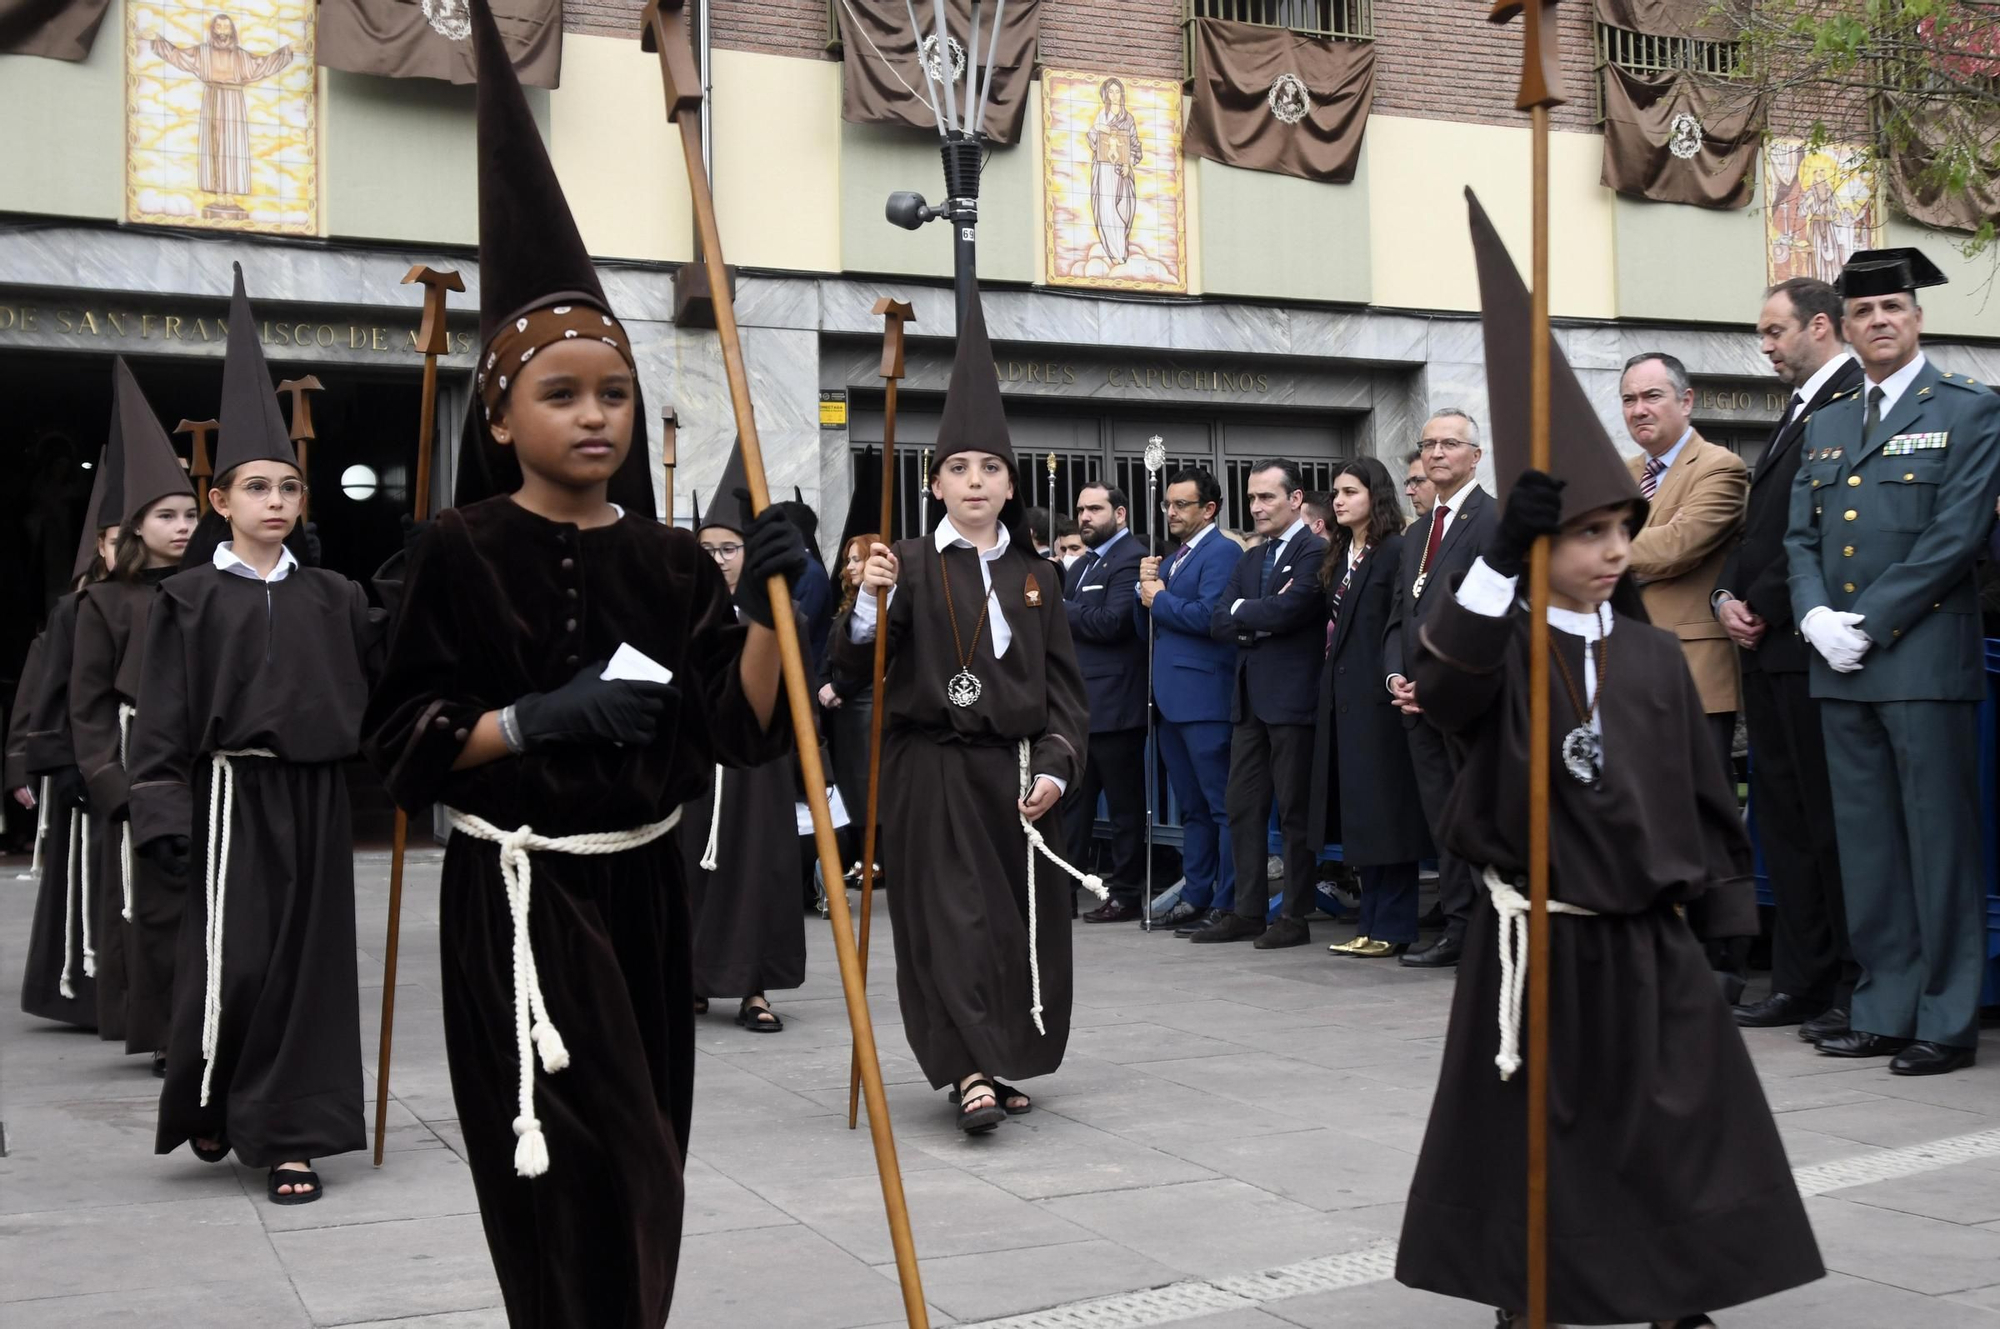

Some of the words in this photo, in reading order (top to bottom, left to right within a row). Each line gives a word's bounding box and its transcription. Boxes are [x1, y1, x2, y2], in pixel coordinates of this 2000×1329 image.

[963, 229, 974, 239] 69
[0, 306, 39, 333] DE
[56, 310, 127, 338] SAN
[140, 314, 335, 348] FRANISCO
[349, 325, 388, 351] DE
[403, 330, 471, 355] AIS
[993, 361, 1075, 385] ADRES
[1107, 367, 1269, 393] CAPUCHINOS
[1700, 390, 1751, 410] EGIO
